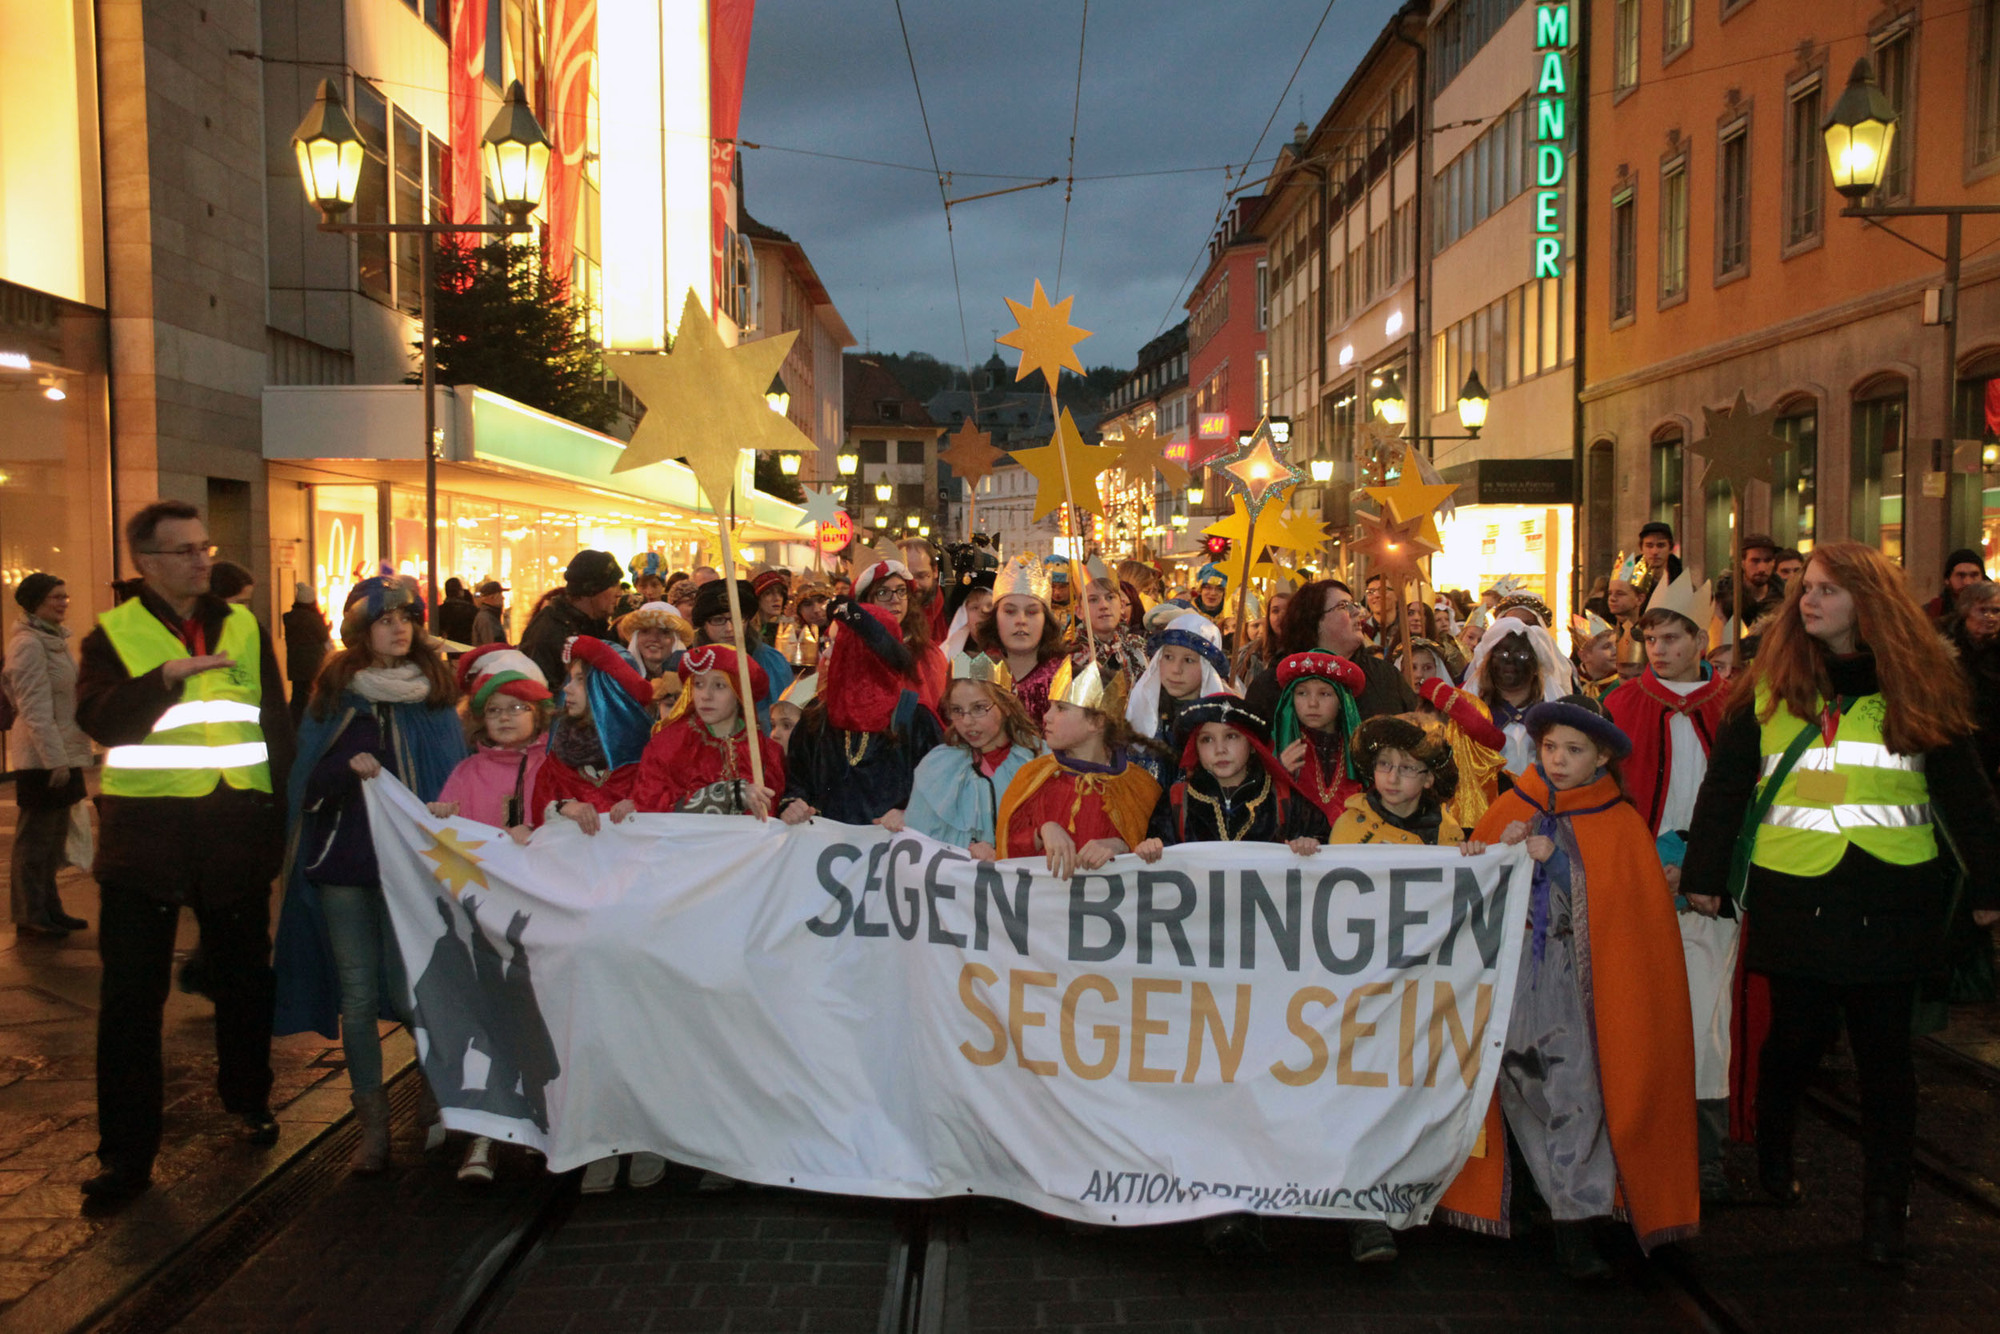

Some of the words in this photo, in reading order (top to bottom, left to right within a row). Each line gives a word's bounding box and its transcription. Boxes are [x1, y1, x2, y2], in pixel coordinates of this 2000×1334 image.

[1536, 5, 1569, 278] MANDER
[1200, 417, 1225, 434] H&M
[806, 838, 1032, 957] SEGEN
[1068, 865, 1514, 975] BRINGEN
[957, 962, 1252, 1085] SEGEN
[1268, 979, 1493, 1089] SEIN
[1079, 1169, 1187, 1203] AKTION
